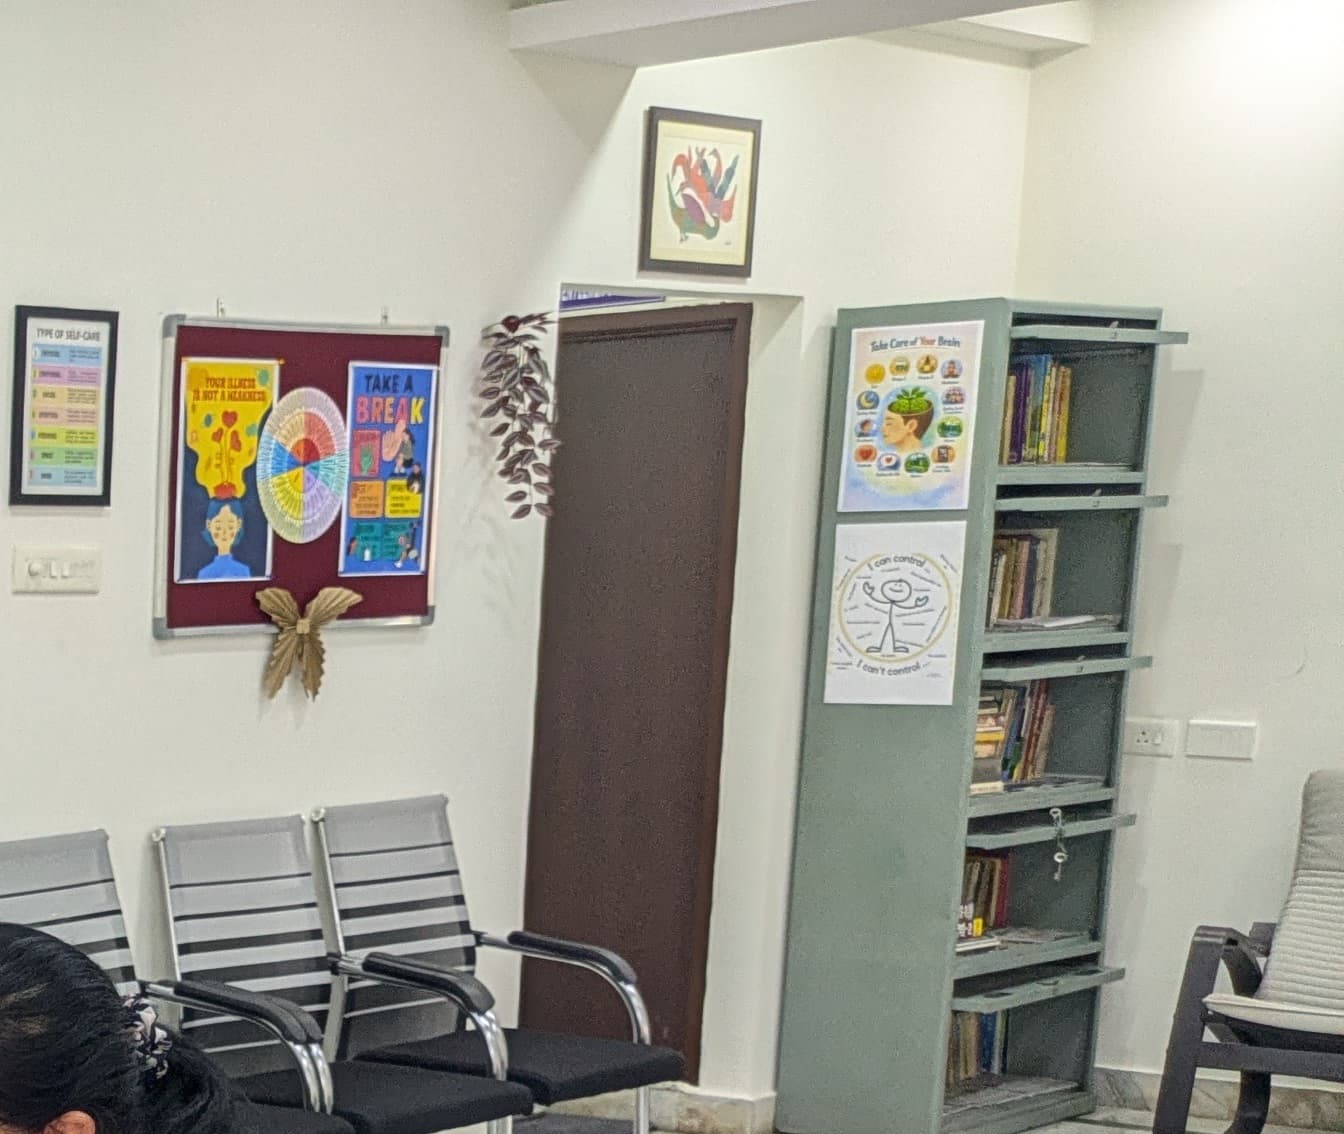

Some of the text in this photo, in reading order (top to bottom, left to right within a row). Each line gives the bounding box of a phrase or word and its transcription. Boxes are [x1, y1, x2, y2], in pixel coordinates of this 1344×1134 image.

[36, 328, 100, 341] TYPE OF SELF-CARE
[870, 336, 961, 352] Take Care of Your Brain
[205, 377, 256, 389] YOUR ILLNESS
[365, 374, 413, 393] TAKE A
[193, 389, 200, 401] IS
[203, 390, 218, 401] NOT
[228, 390, 266, 402] WEAKNESS
[356, 396, 425, 425] BREAK
[874, 557, 891, 567] can
[893, 555, 926, 568] control
[862, 664, 886, 675] can't
[887, 662, 921, 676] control
